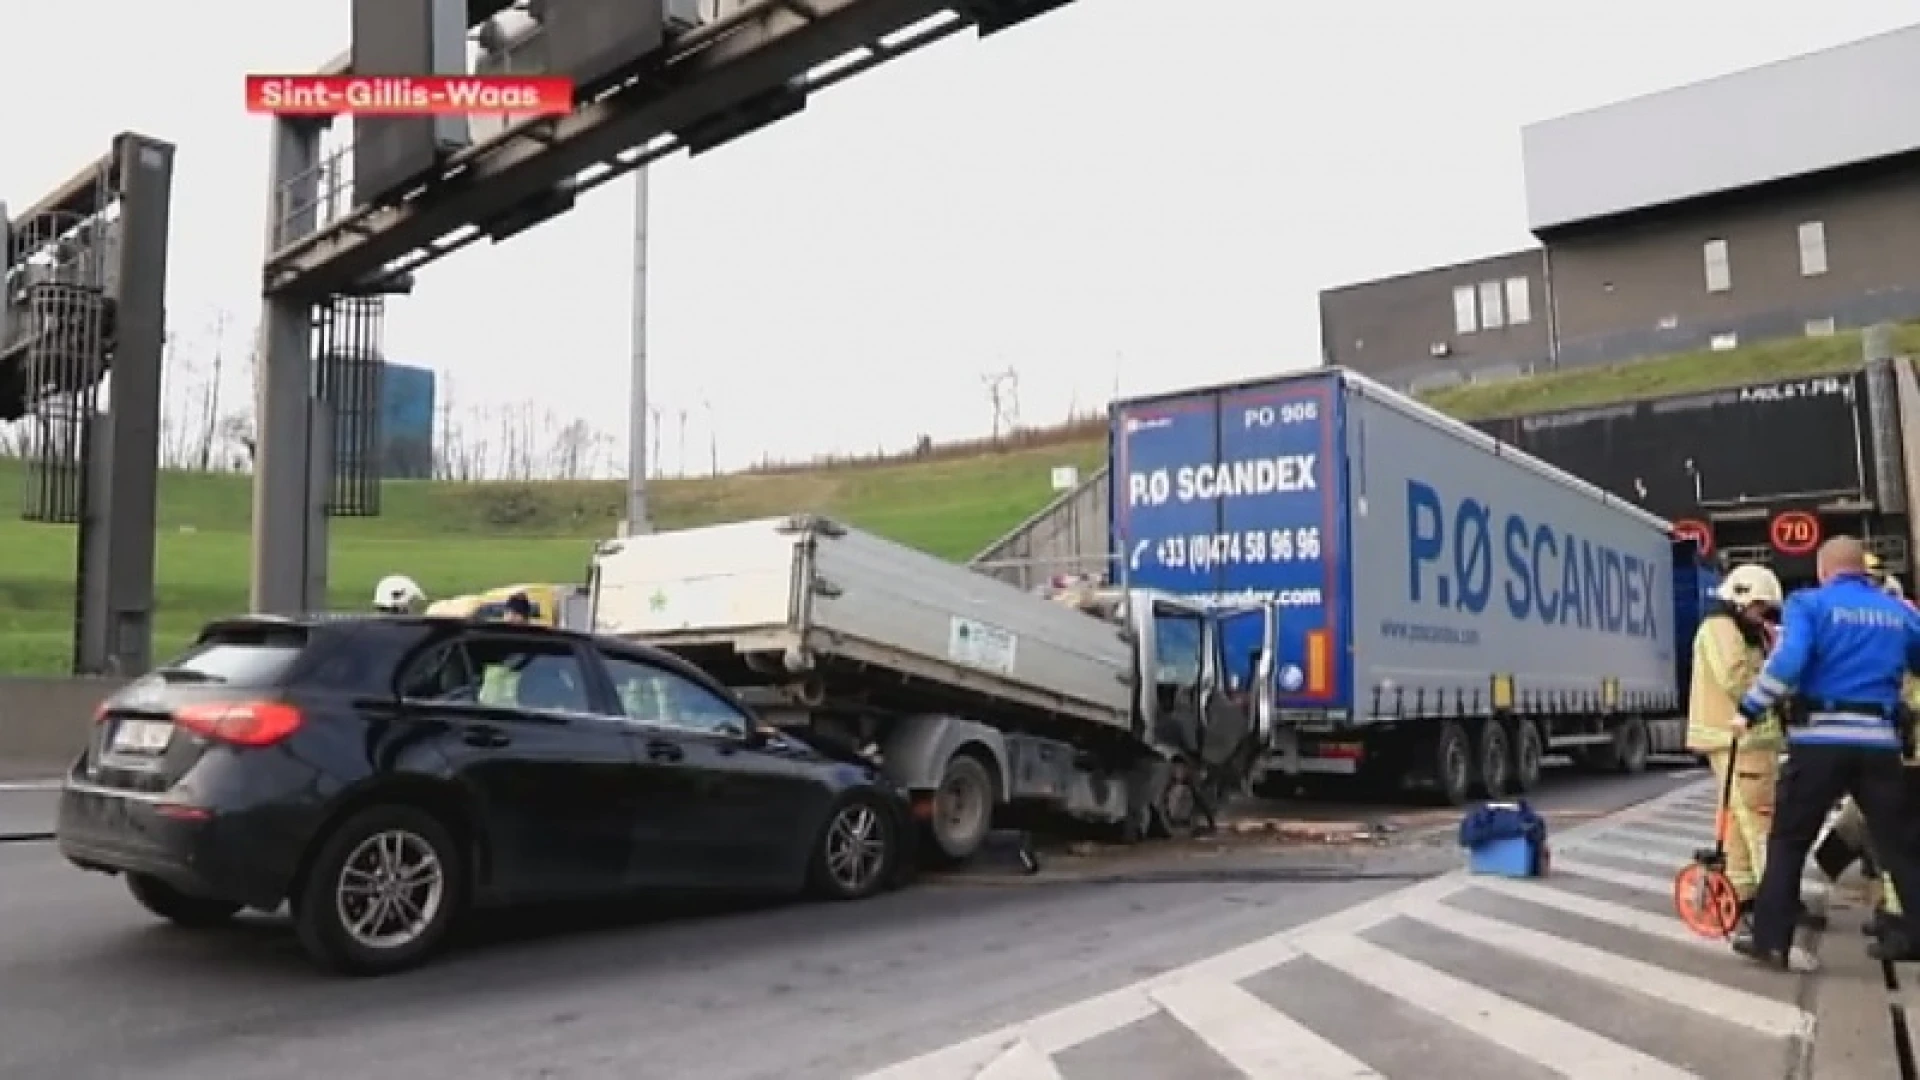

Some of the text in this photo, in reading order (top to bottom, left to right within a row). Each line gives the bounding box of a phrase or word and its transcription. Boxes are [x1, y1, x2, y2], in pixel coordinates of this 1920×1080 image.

[1245, 402, 1317, 428] PO 906
[1177, 454, 1316, 503] SCANDEX
[1157, 534, 1186, 567] +33
[1245, 530, 1266, 562] 58
[1297, 526, 1321, 560] 96
[1779, 522, 1808, 541] 70
[1406, 478, 1657, 640] P.Ø SCANDEX
